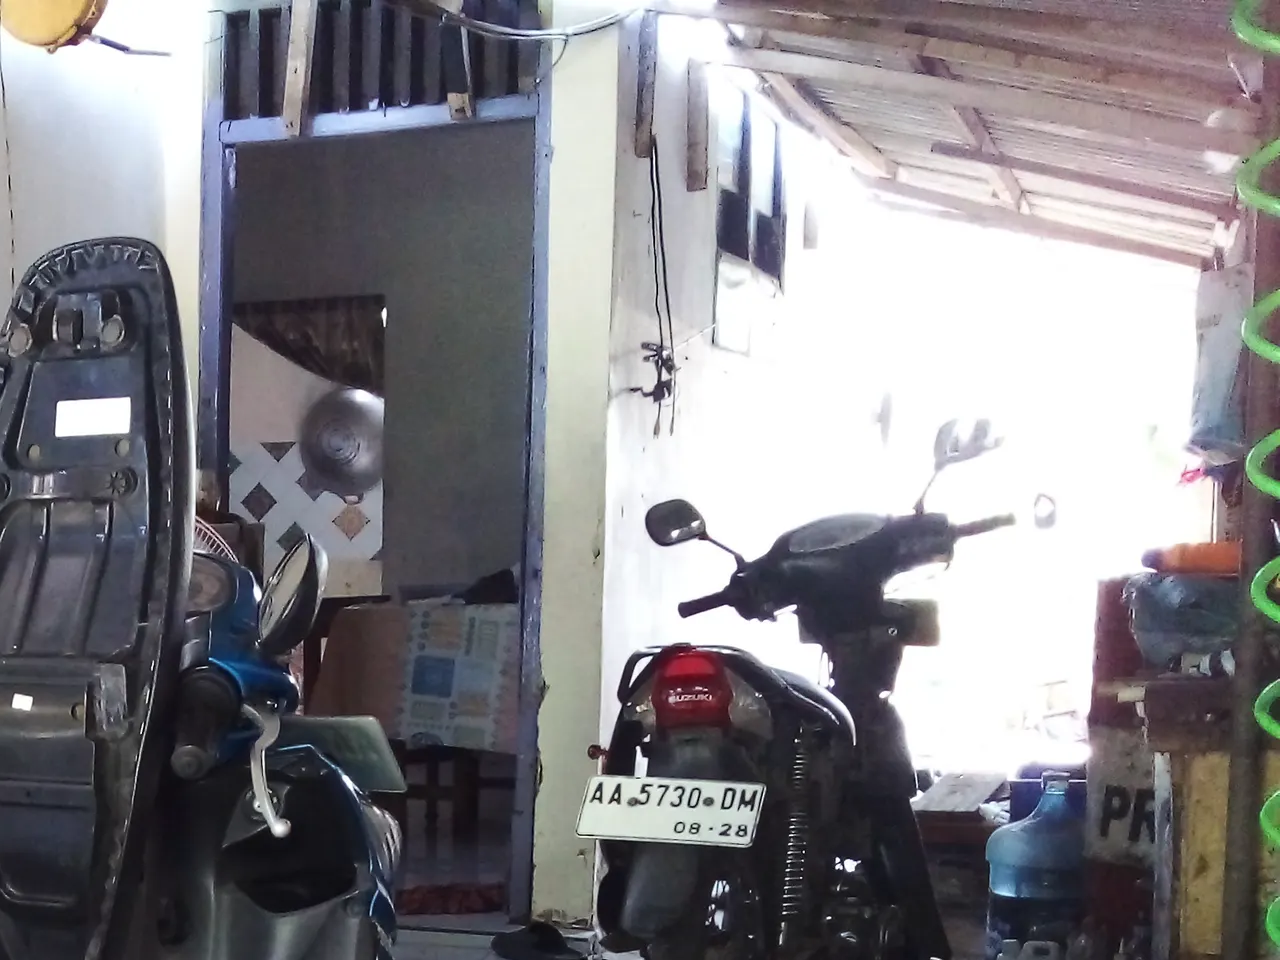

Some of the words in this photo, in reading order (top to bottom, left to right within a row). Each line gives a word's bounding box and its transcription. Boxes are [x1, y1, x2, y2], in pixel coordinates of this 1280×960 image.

[589, 782, 622, 807] AA
[637, 783, 702, 809] 5730
[721, 788, 758, 812] DM
